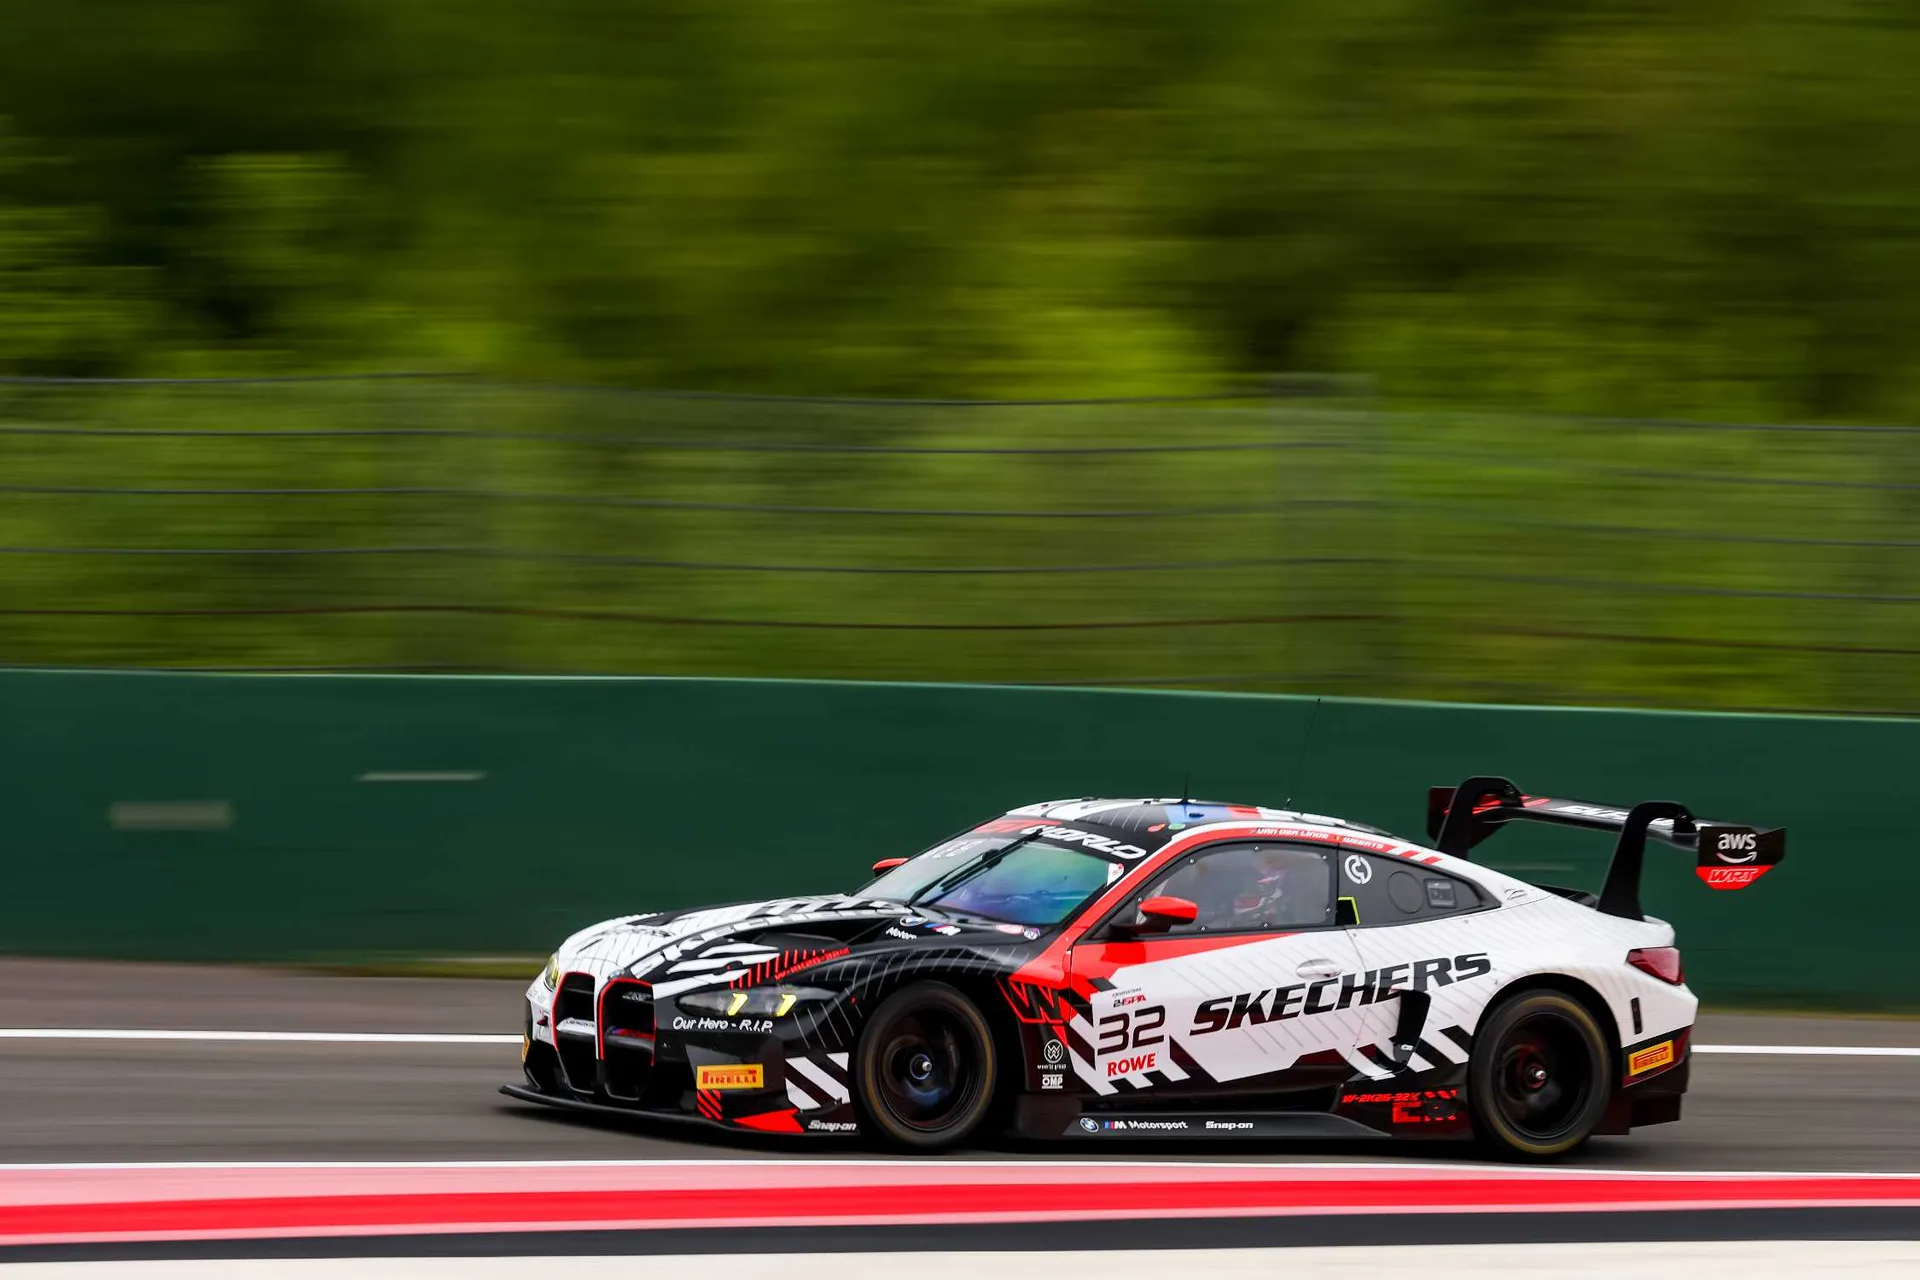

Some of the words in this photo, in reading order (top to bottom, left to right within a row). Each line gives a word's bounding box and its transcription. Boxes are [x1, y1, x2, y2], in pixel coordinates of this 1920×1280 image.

[1019, 824, 1147, 860] WORLD
[1717, 833, 1757, 850] aws
[1707, 868, 1758, 883] WRT
[1190, 952, 1491, 1036] SKECHERS
[672, 1016, 697, 1030] Our
[697, 1017, 729, 1030] Hero
[1097, 1004, 1166, 1056] 32
[1107, 1053, 1156, 1077] ROWE
[1633, 1046, 1669, 1070] PIRELLI
[702, 1069, 757, 1084] PIRELLI
[1042, 1076, 1063, 1087] OMP
[807, 1119, 857, 1132] Snap-on
[1127, 1120, 1189, 1131] Motorsport
[1205, 1120, 1254, 1131] Snap-on
